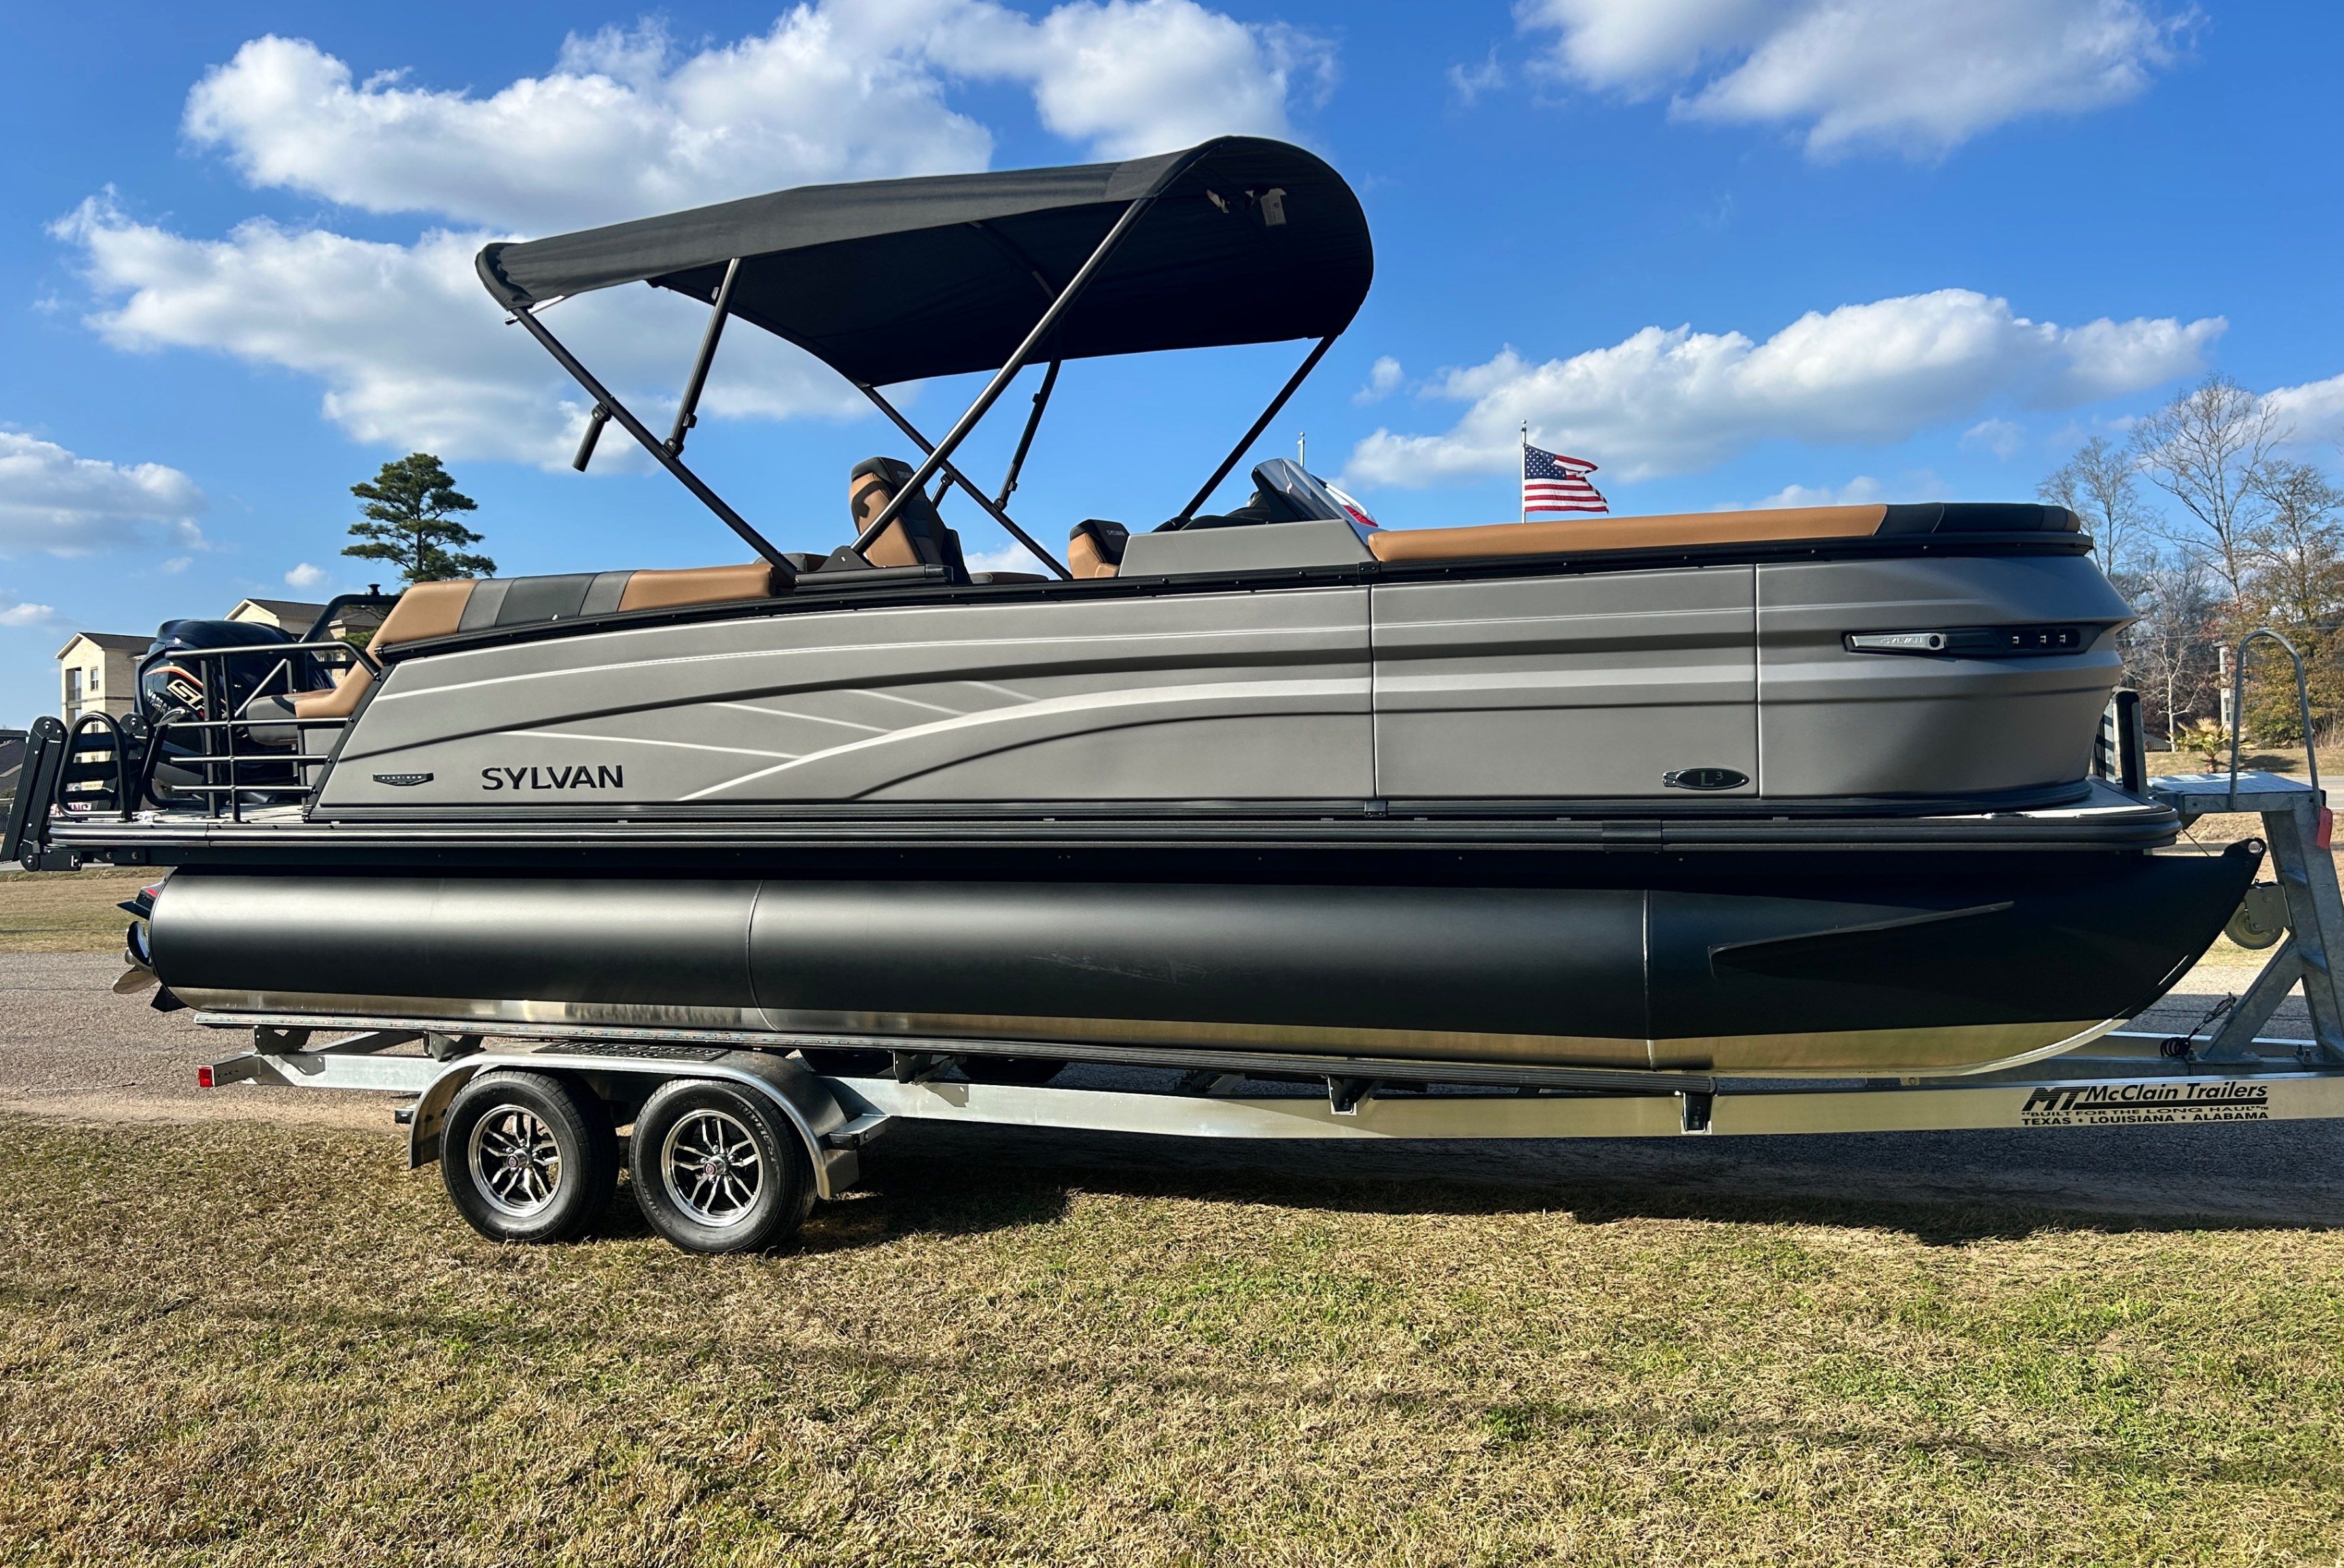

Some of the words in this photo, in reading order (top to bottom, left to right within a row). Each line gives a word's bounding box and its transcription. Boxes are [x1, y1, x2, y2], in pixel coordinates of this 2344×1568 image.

[481, 765, 623, 790] SYLVAN
[2021, 1087, 2090, 1111] MT
[2084, 1084, 2178, 1102] McClain
[2186, 1081, 2268, 1099] Trailers
[2090, 1115, 2175, 1124] LOUISIANA
[2193, 1112, 2268, 1121] ALABAMA
